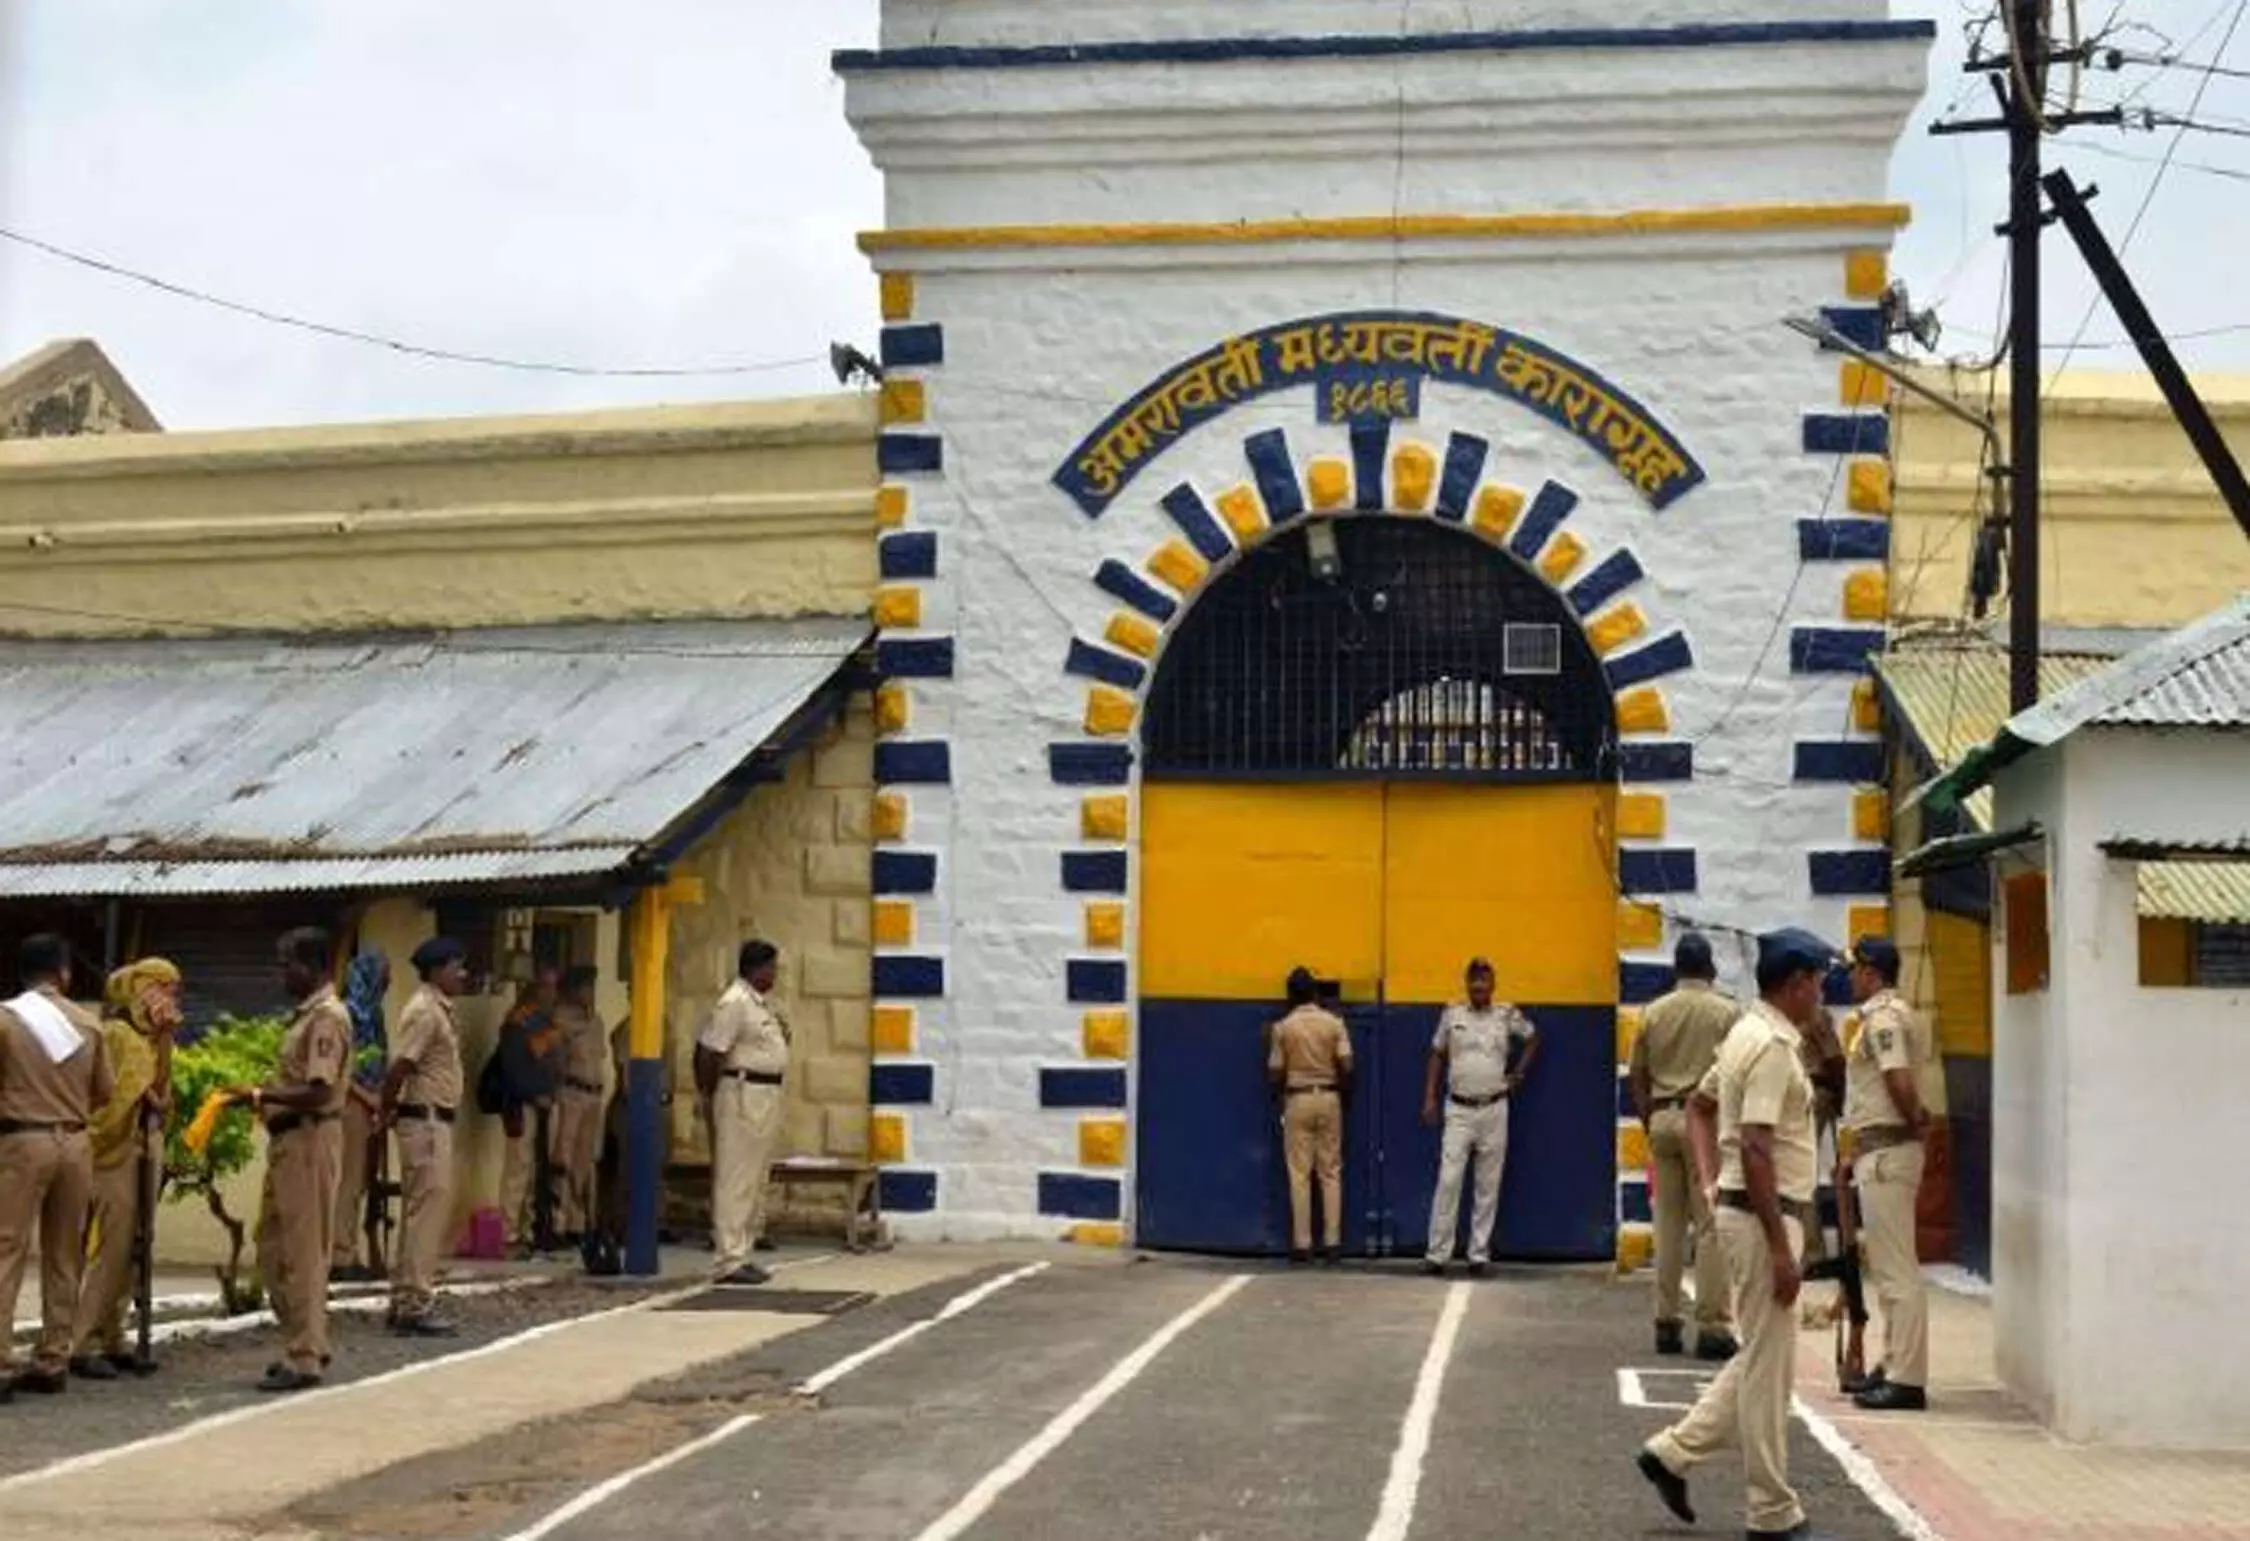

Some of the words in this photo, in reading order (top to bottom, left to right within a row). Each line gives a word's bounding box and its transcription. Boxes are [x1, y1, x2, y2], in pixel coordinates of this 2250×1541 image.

[1078, 335, 1263, 496] अमरावती
[1274, 320, 1495, 374] मध्यवर्ती
[1496, 343, 1688, 492] कारागृह
